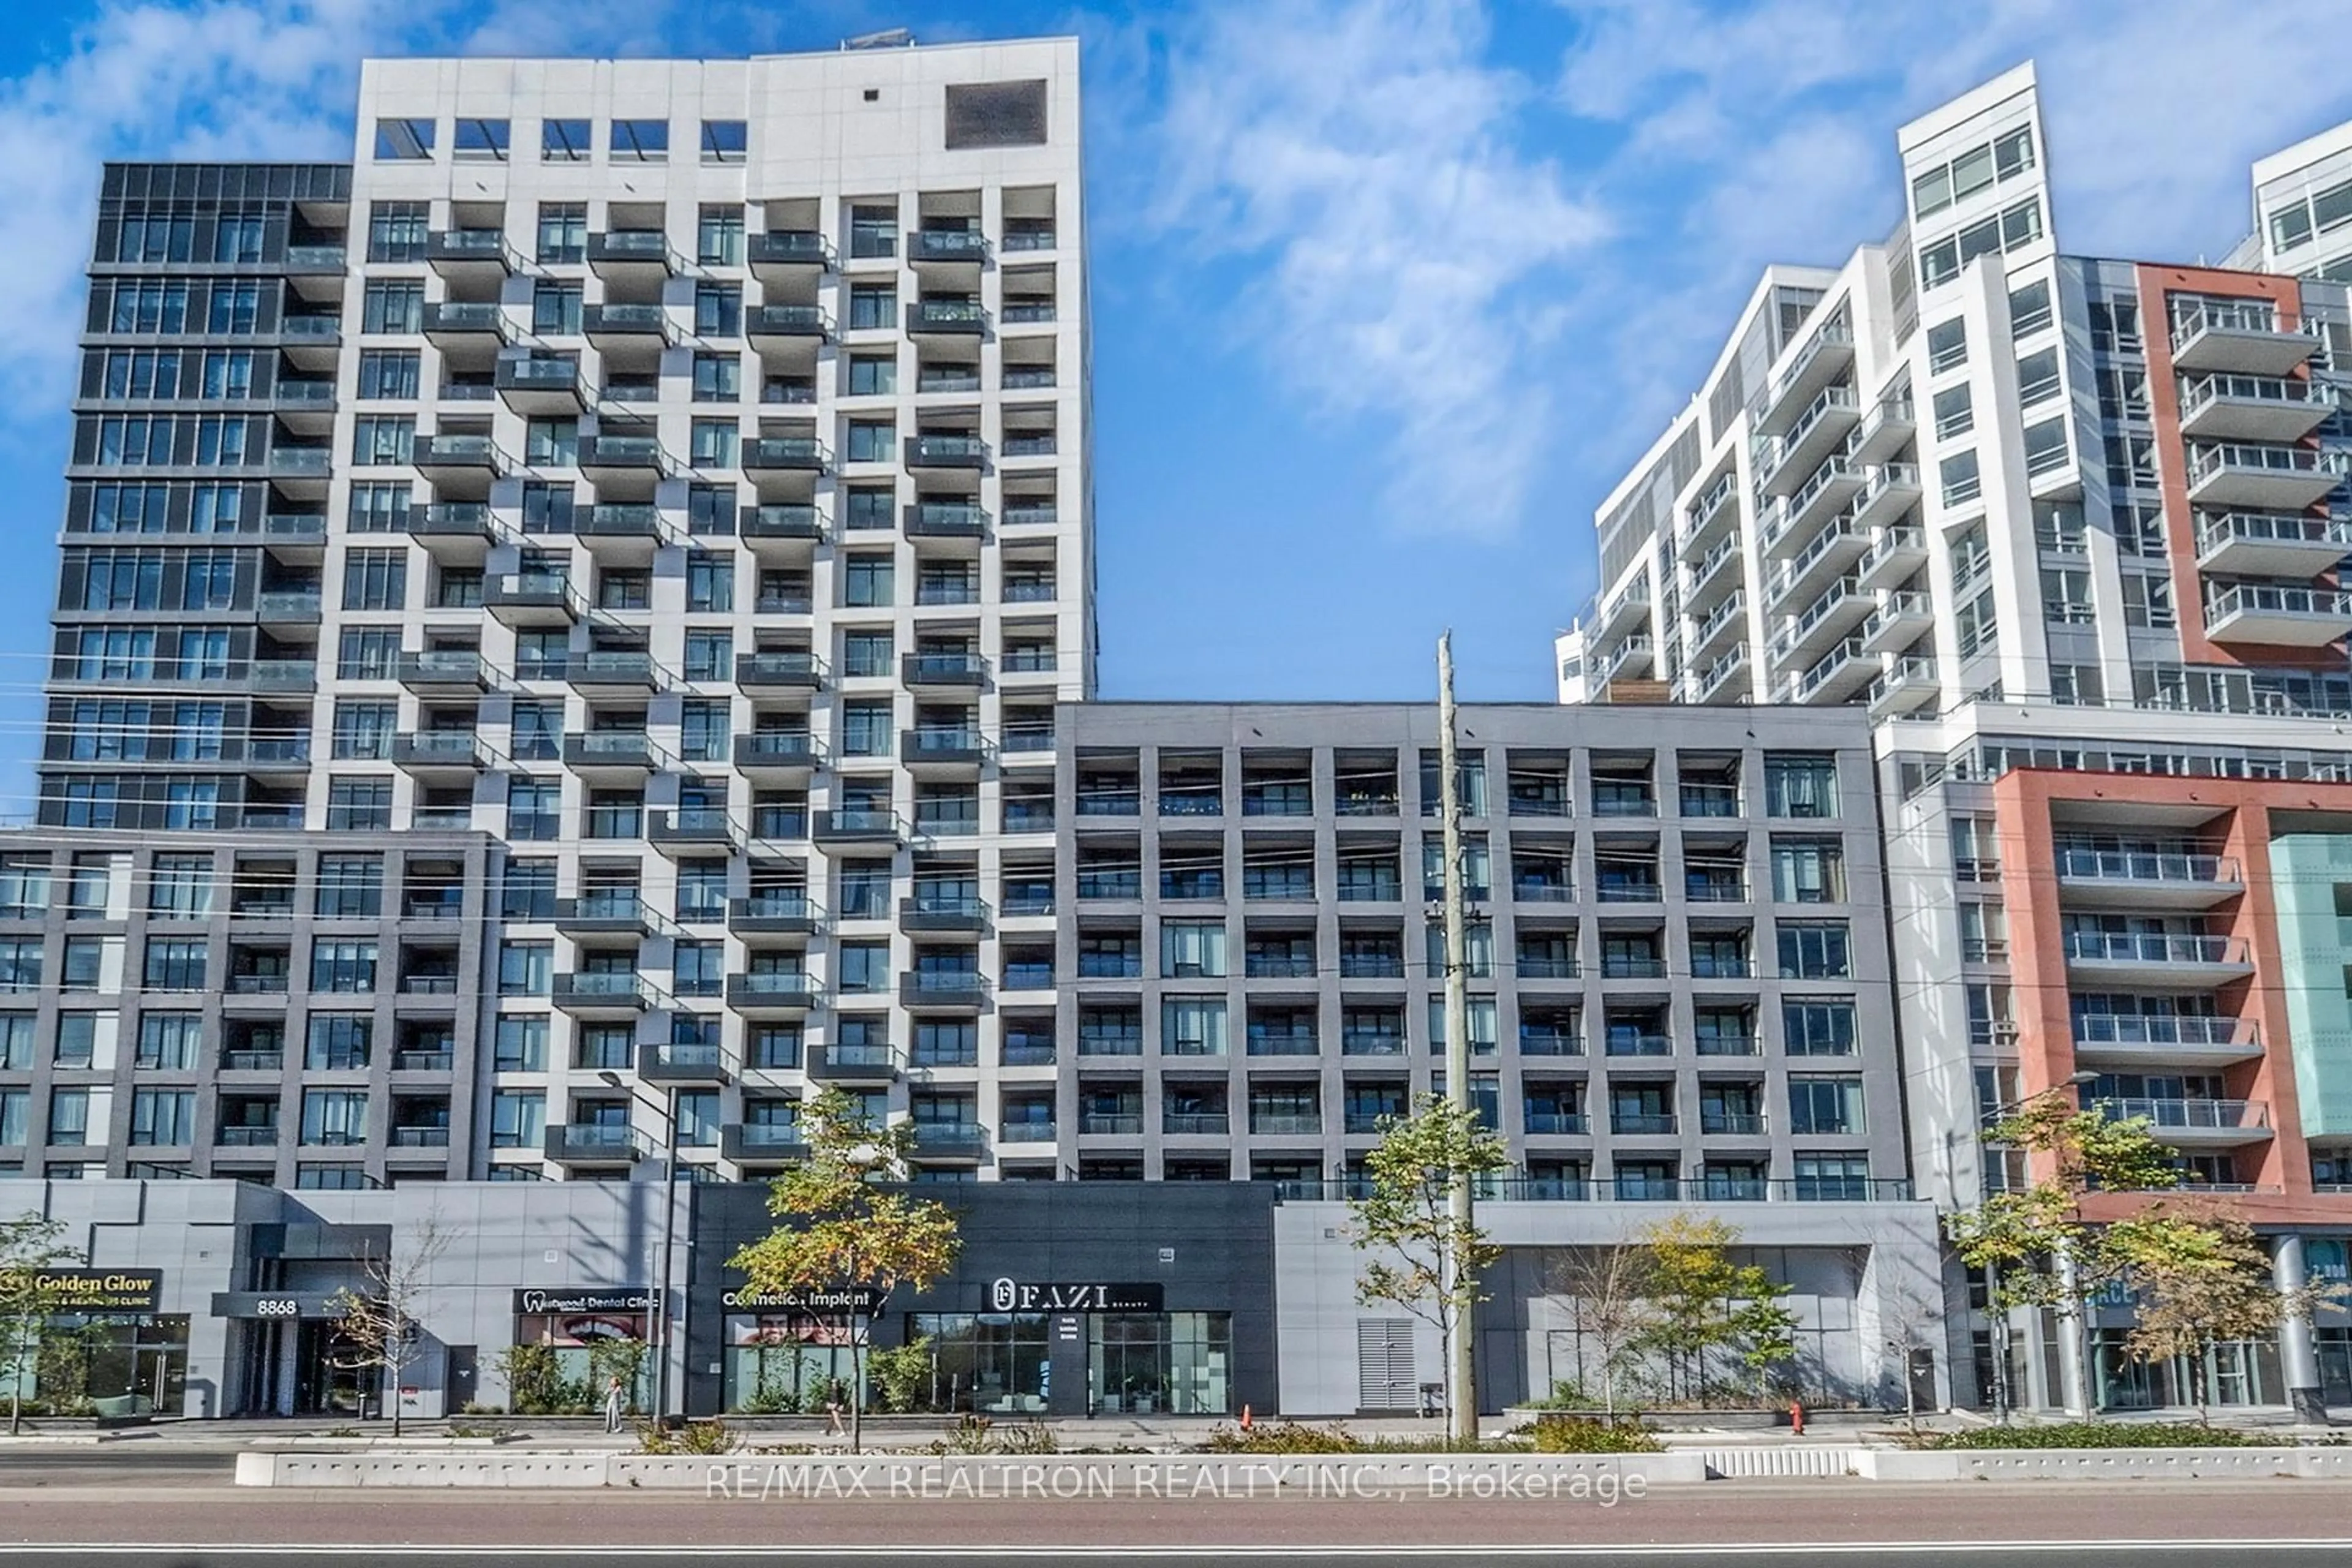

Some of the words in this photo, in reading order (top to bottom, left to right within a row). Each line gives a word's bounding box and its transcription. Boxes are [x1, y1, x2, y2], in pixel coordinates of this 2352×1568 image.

[35, 1274, 101, 1291] Golden
[104, 1275, 153, 1291] Glow
[588, 1297, 624, 1308] Dental
[627, 1297, 659, 1308] Clinc
[722, 1292, 798, 1306] Cometic
[810, 1292, 869, 1307] Implant
[1020, 1286, 1108, 1308] FAZI
[258, 1300, 296, 1314] 8868
